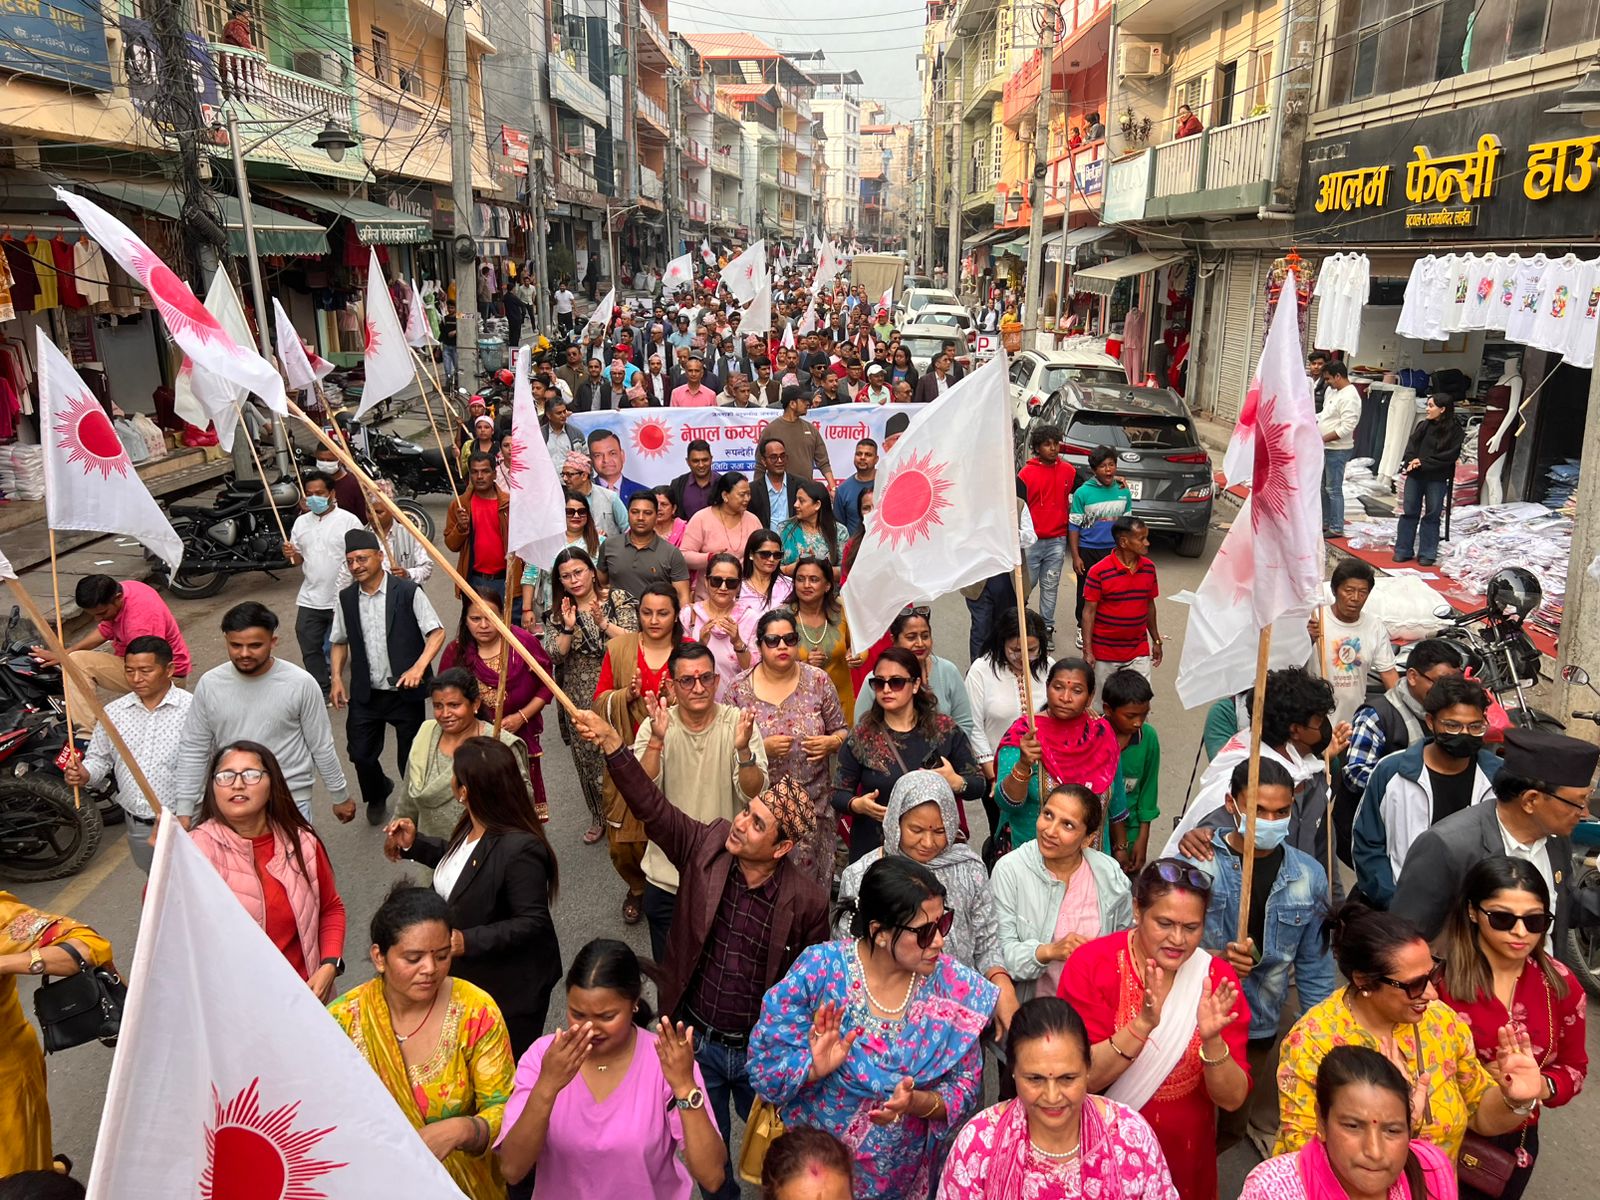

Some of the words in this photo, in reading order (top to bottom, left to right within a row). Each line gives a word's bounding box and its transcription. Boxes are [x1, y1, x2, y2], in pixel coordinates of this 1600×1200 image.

[1314, 165, 1391, 213] आलम
[1405, 133, 1501, 204] फेन्सी
[1522, 134, 1600, 200] हाउ
[978, 337, 989, 352] P
[680, 424, 720, 442] नेपाल
[824, 421, 871, 440] (एमाले)
